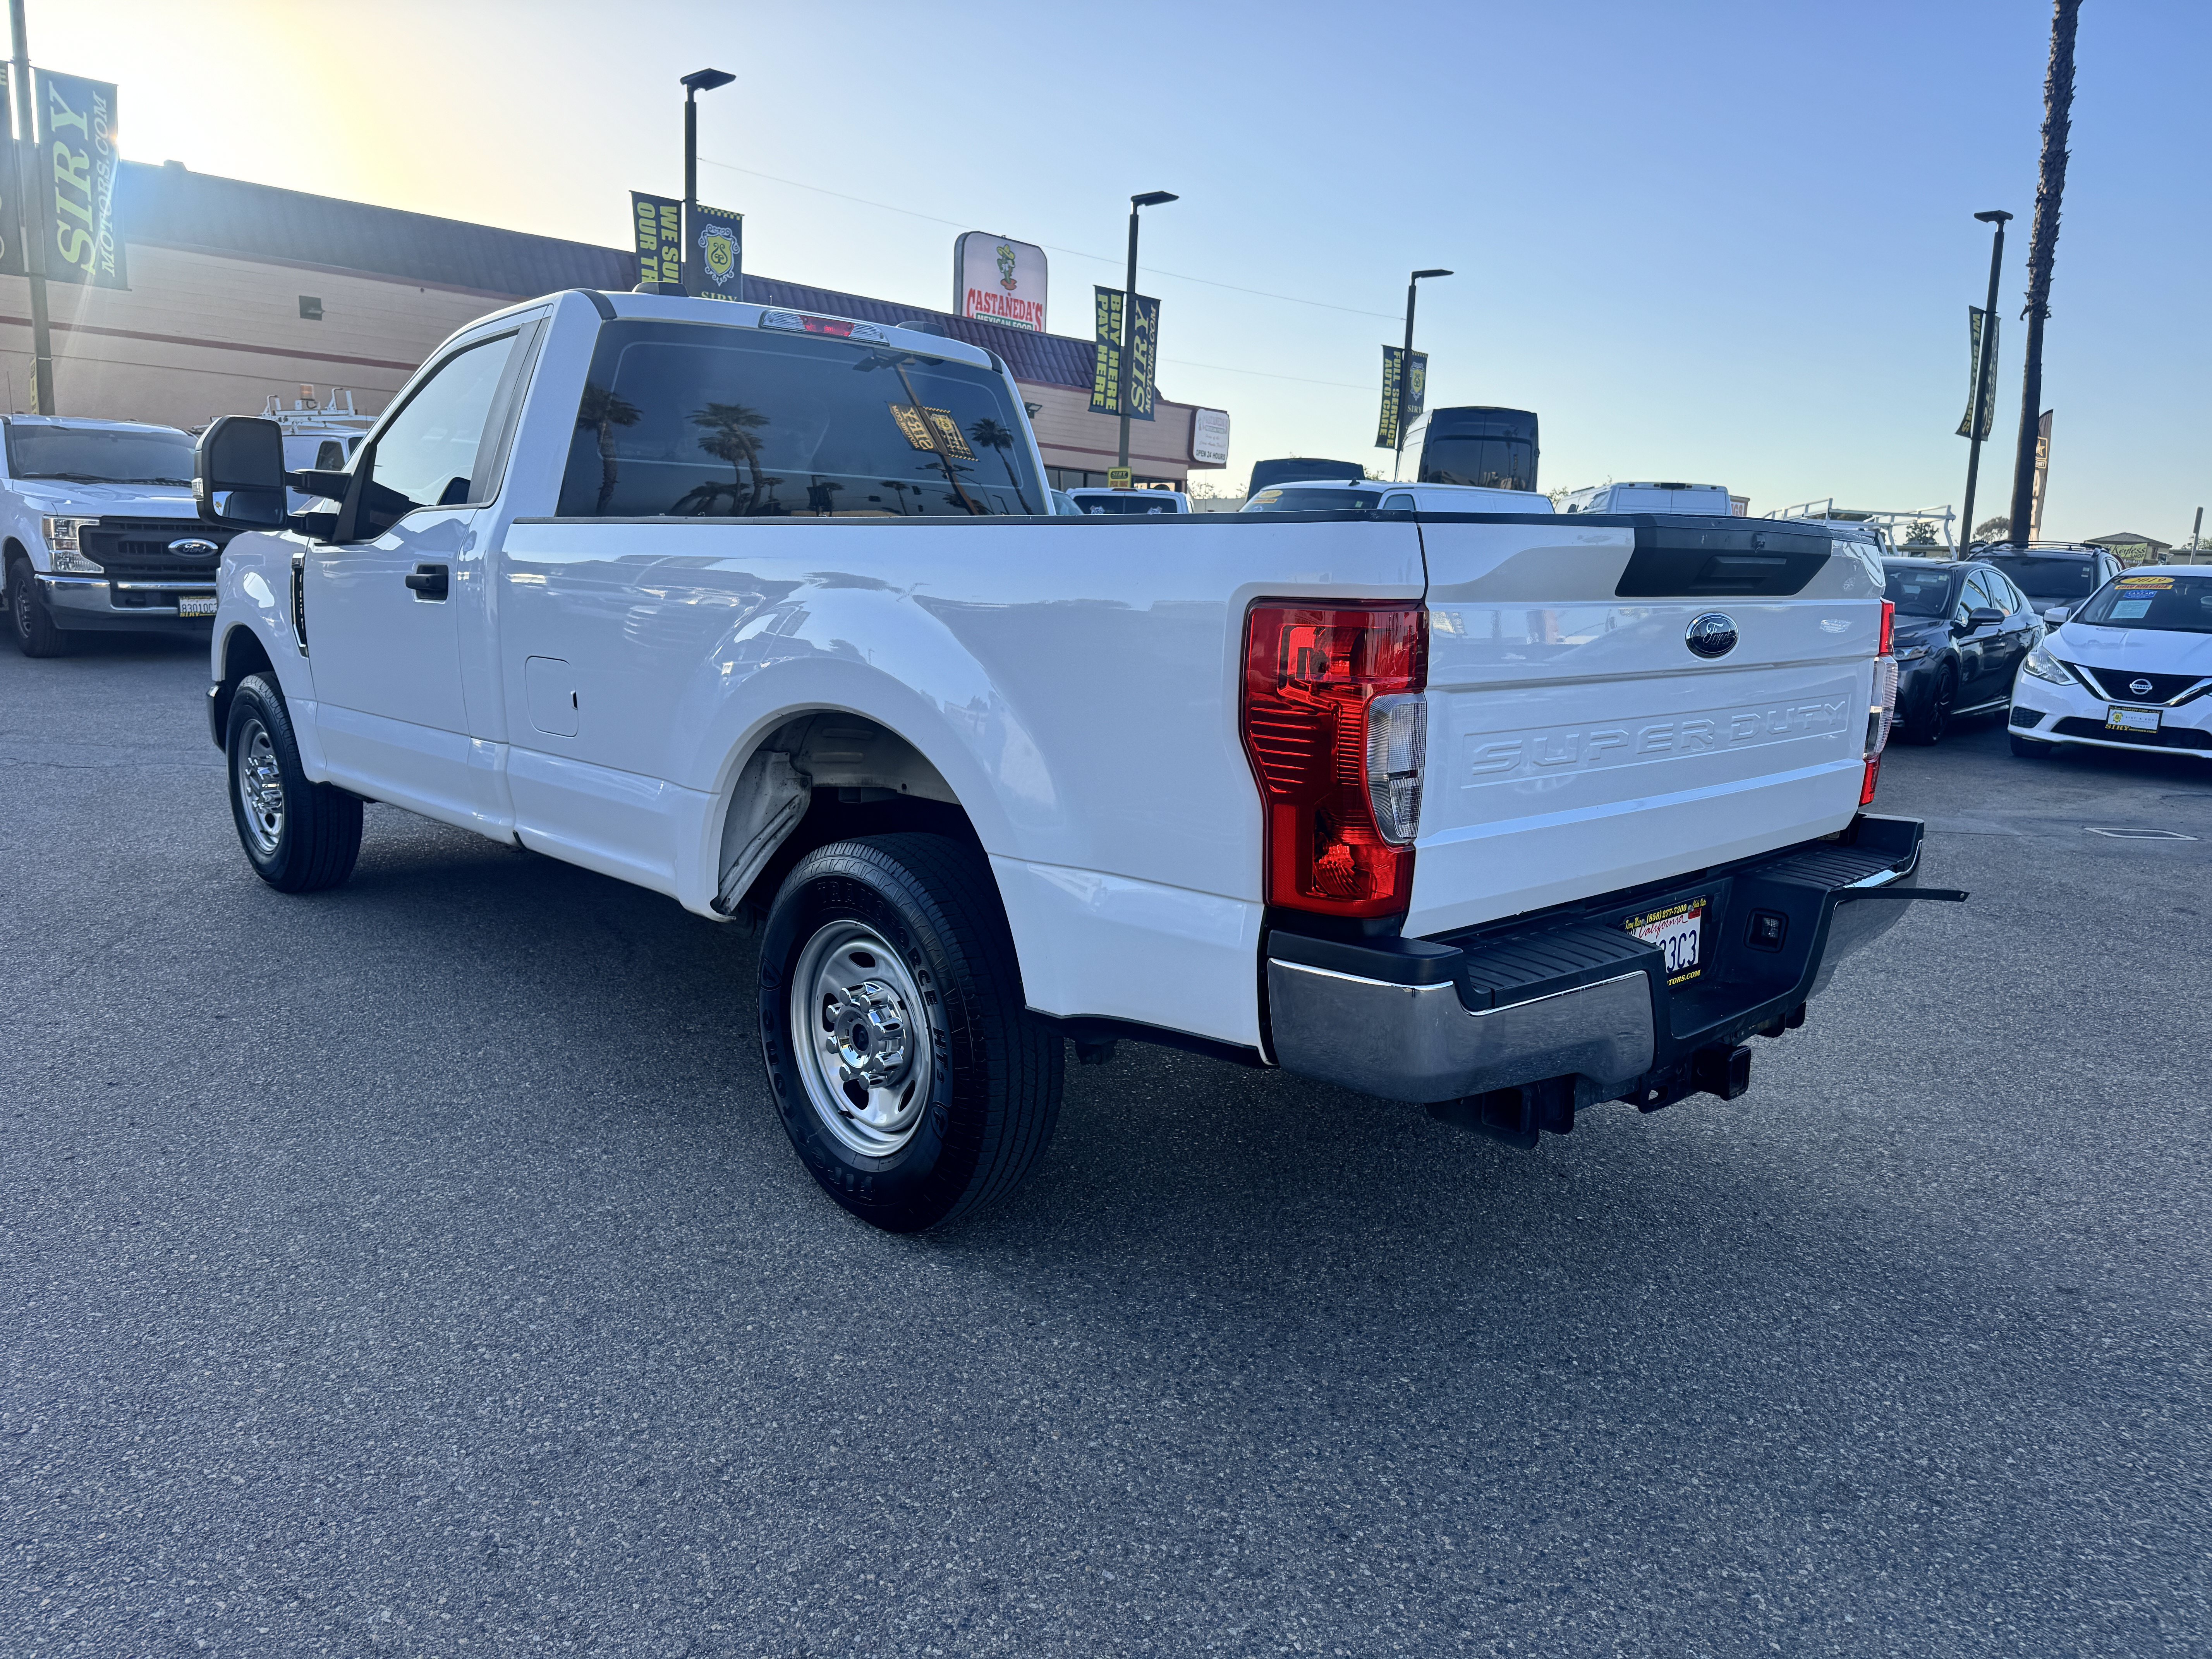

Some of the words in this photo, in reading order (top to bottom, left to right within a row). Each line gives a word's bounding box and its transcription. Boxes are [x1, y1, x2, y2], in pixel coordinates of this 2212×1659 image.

[49, 81, 96, 276] SIRY
[93, 91, 115, 276] MOTORS.COM
[637, 202, 657, 251] OUR
[660, 206, 678, 242] WE
[967, 288, 1042, 332] CASTAÑEDA'S
[1097, 294, 1108, 340] PAY
[1110, 294, 1121, 345] BUY
[1973, 314, 1980, 341] WE
[1092, 345, 1108, 406] HERE
[1131, 300, 1149, 413] SIRY
[1145, 304, 1156, 414] MOTORS.COM
[1384, 359, 1393, 397] AUTO
[1393, 351, 1401, 382] FULL
[1106, 350, 1119, 410] HERE
[1379, 400, 1391, 436] CARE
[1386, 388, 1400, 446] SERVICE
[1407, 405, 1423, 413] SIRY
[1196, 449, 1206, 457] OPEN
[1212, 452, 1226, 461] HOURS
[183, 544, 206, 553] Ford
[2112, 545, 2146, 557] Keyless
[1703, 622, 1731, 646] Ford
[1472, 719, 1716, 775] SUPER
[1728, 701, 1846, 742] DUTY
[817, 881, 939, 1006] TRANSFORCE
[1638, 914, 1688, 939] California
[1667, 969, 1701, 986] TORS.COM
